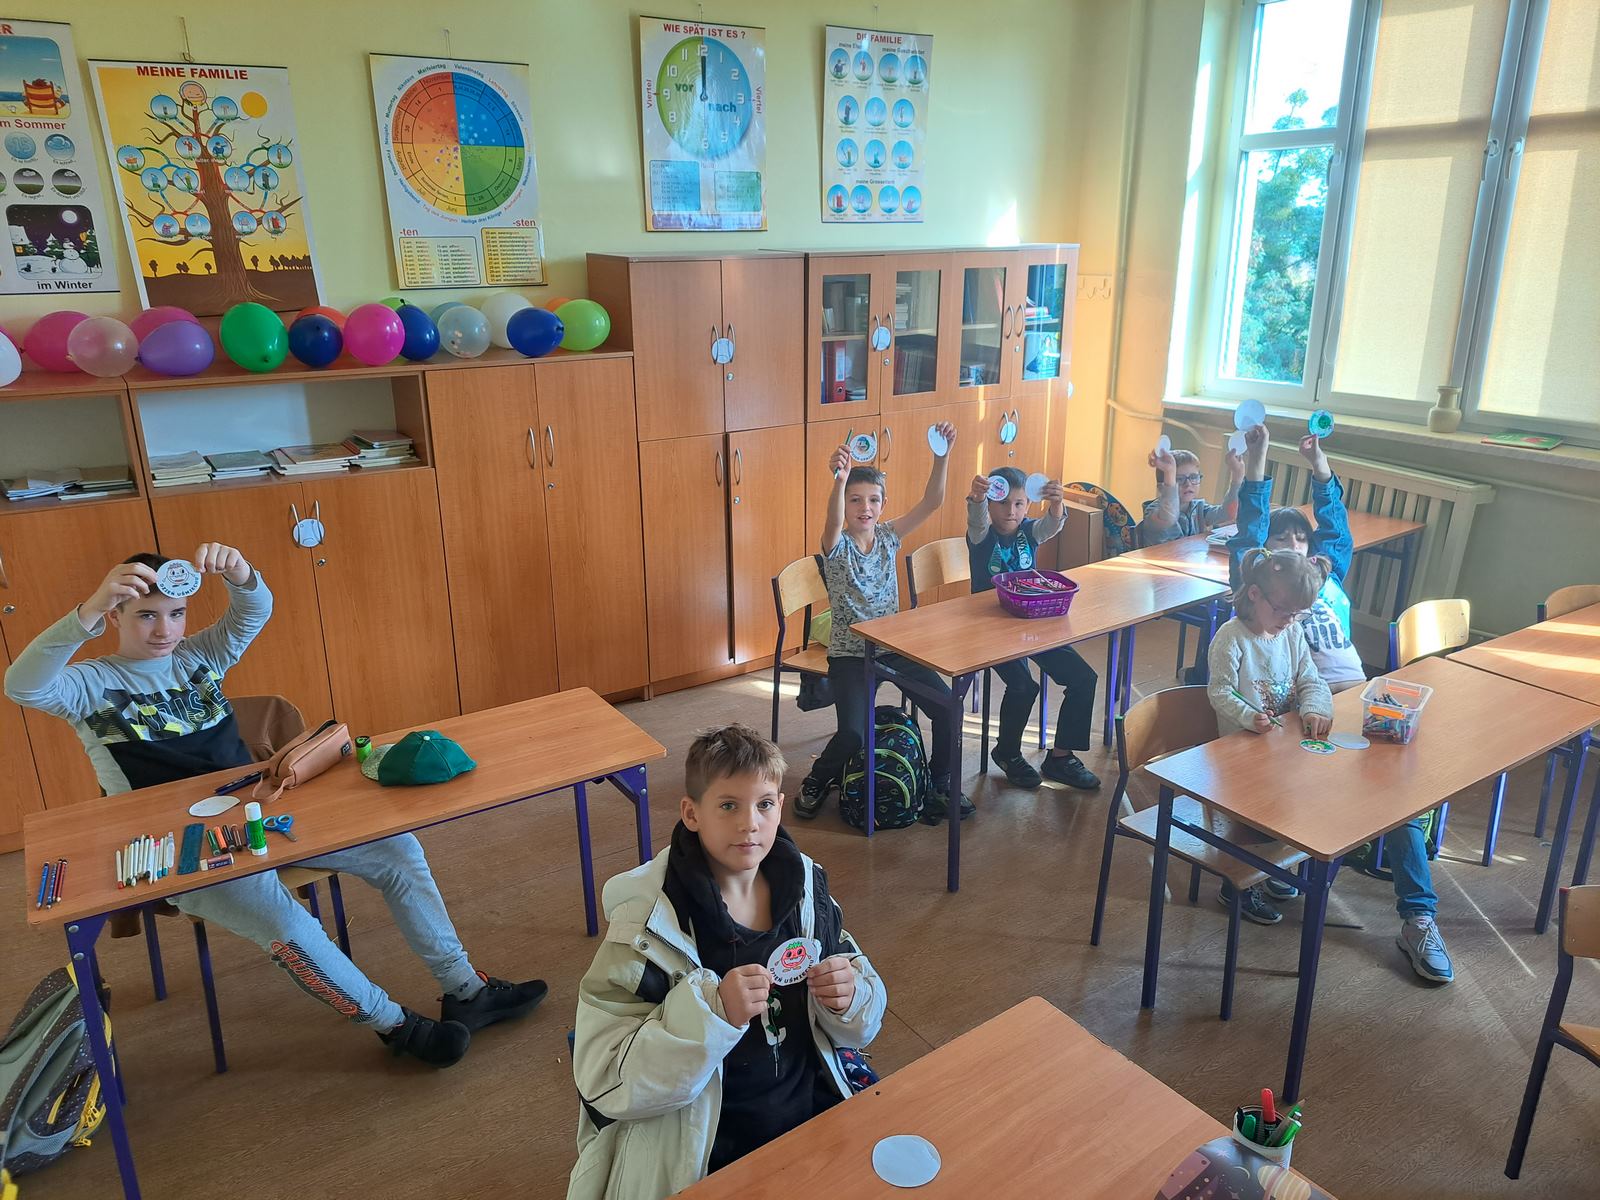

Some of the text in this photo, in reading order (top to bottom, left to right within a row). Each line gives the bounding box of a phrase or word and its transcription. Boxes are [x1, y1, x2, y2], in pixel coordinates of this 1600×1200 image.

[663, 23, 680, 33] WIE
[683, 24, 705, 35] SPÄT
[708, 28, 723, 37] IST
[726, 30, 738, 38] ES
[870, 34, 903, 45] FAMILIE
[697, 44, 708, 57] 12
[136, 66, 249, 80] MEINE FAMILIE
[666, 64, 678, 77] 10
[731, 68, 739, 80] 2
[663, 88, 671, 100] 9
[674, 83, 694, 93] vor
[737, 93, 745, 104] 3
[708, 102, 737, 113] nach
[669, 111, 676, 123] 8
[15, 119, 66, 130] Sommer
[721, 130, 728, 143] 5
[702, 138, 709, 150] 6
[512, 219, 536, 227] -sten
[400, 228, 419, 236] -ten
[37, 281, 93, 290] im Winter
